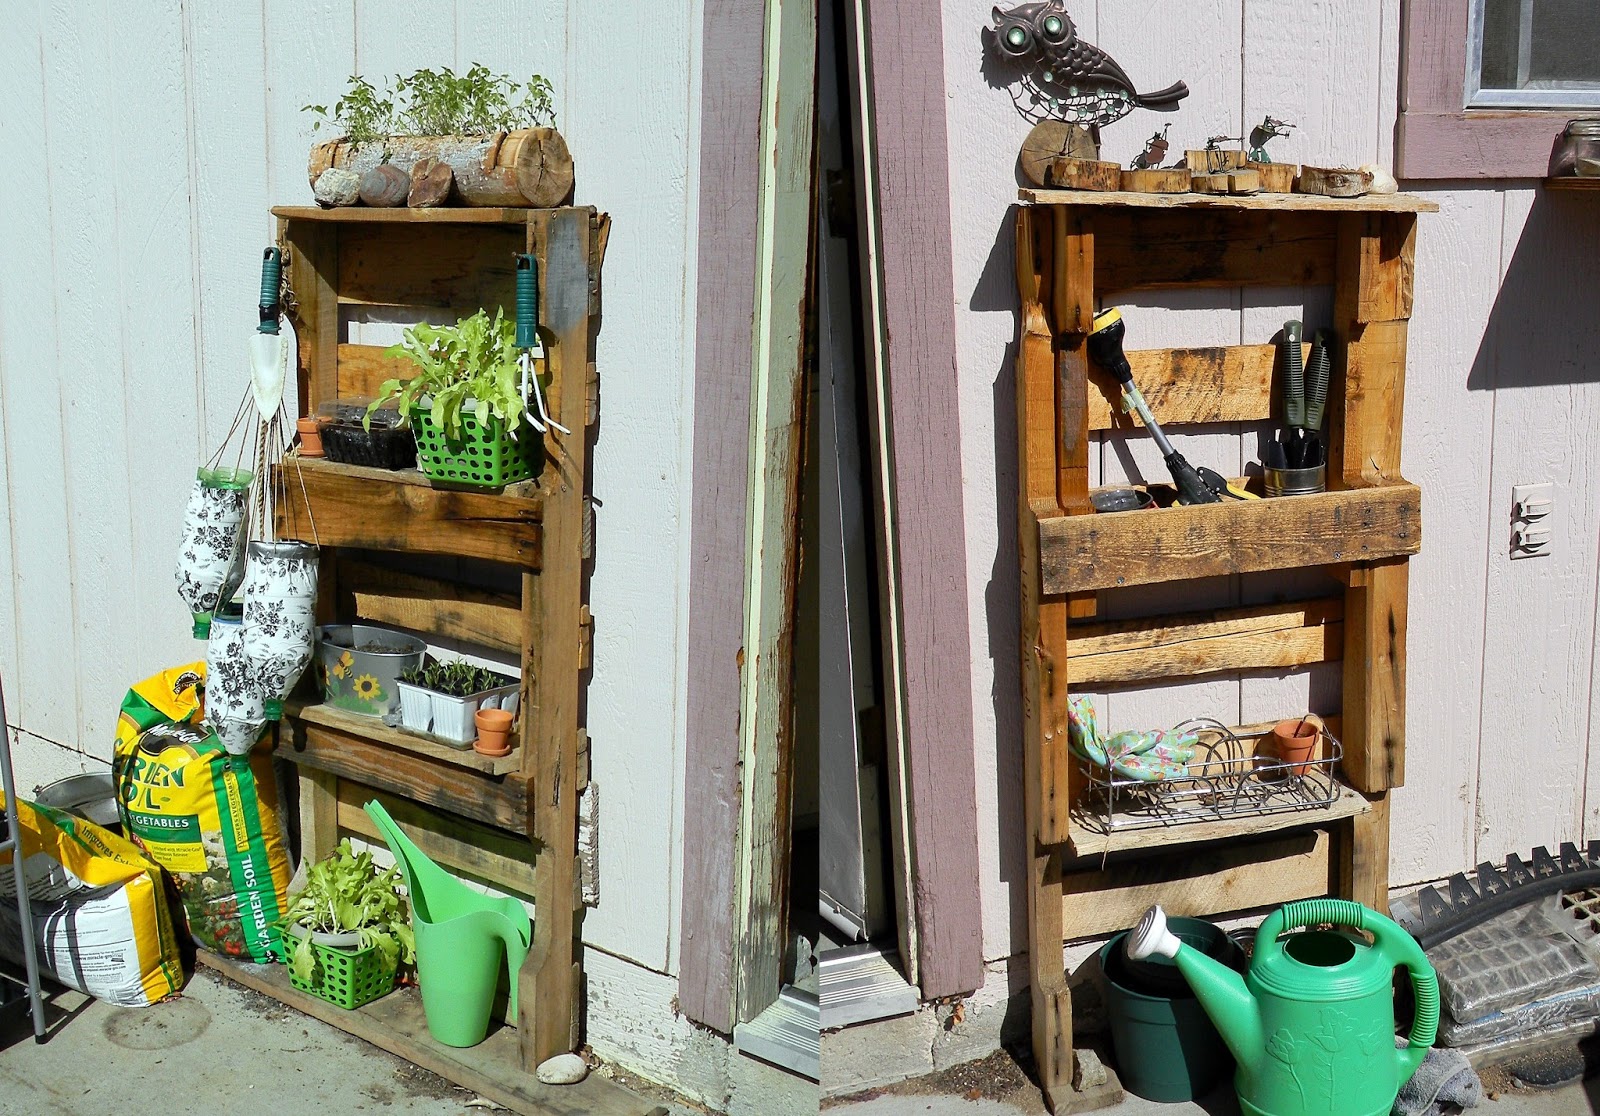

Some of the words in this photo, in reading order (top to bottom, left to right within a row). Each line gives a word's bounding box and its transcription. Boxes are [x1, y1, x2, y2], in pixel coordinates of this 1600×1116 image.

[120, 782, 161, 810] OIL
[81, 825, 114, 858] Improves
[241, 854, 257, 889] SOIL
[248, 890, 271, 948] GARDEN
